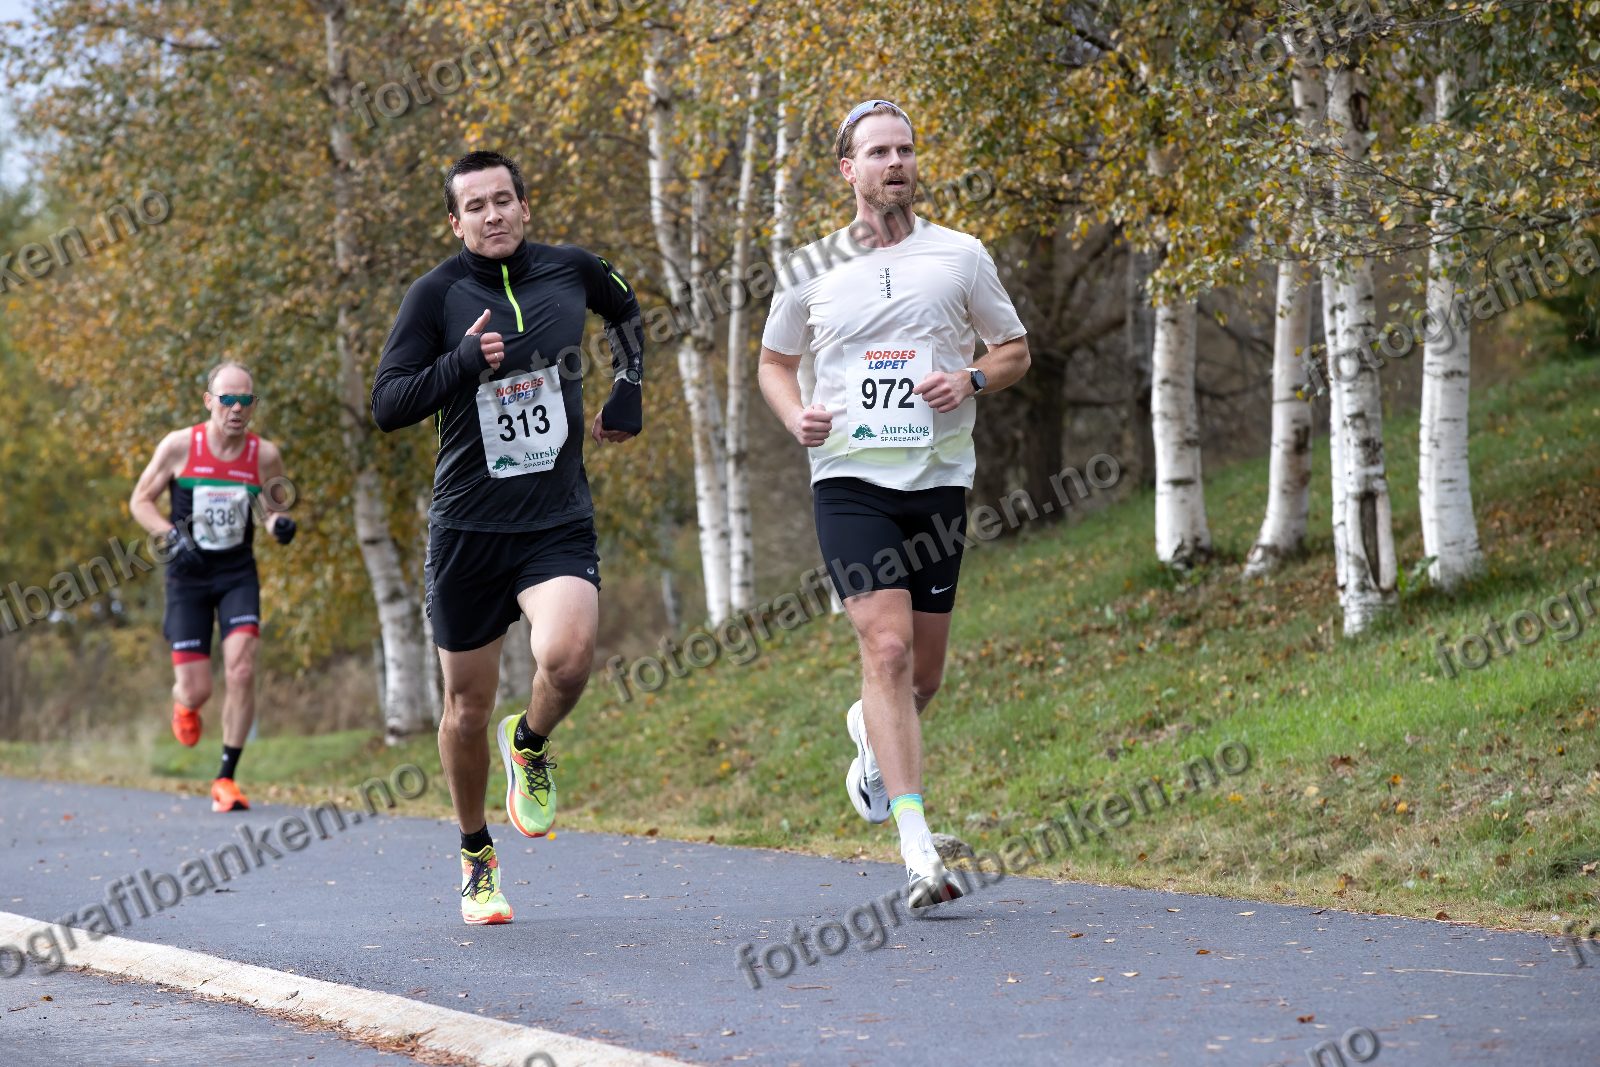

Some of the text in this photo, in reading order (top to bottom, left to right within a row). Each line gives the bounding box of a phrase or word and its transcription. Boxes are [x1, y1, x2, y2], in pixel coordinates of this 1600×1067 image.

[862, 350, 917, 361] NORGES
[868, 359, 908, 371] LØPET
[495, 377, 545, 398] NORGES
[861, 377, 915, 410] 972
[501, 388, 538, 406] LØPET
[497, 404, 551, 442] 313
[880, 423, 930, 437] Aurskog
[205, 508, 236, 527] 338
